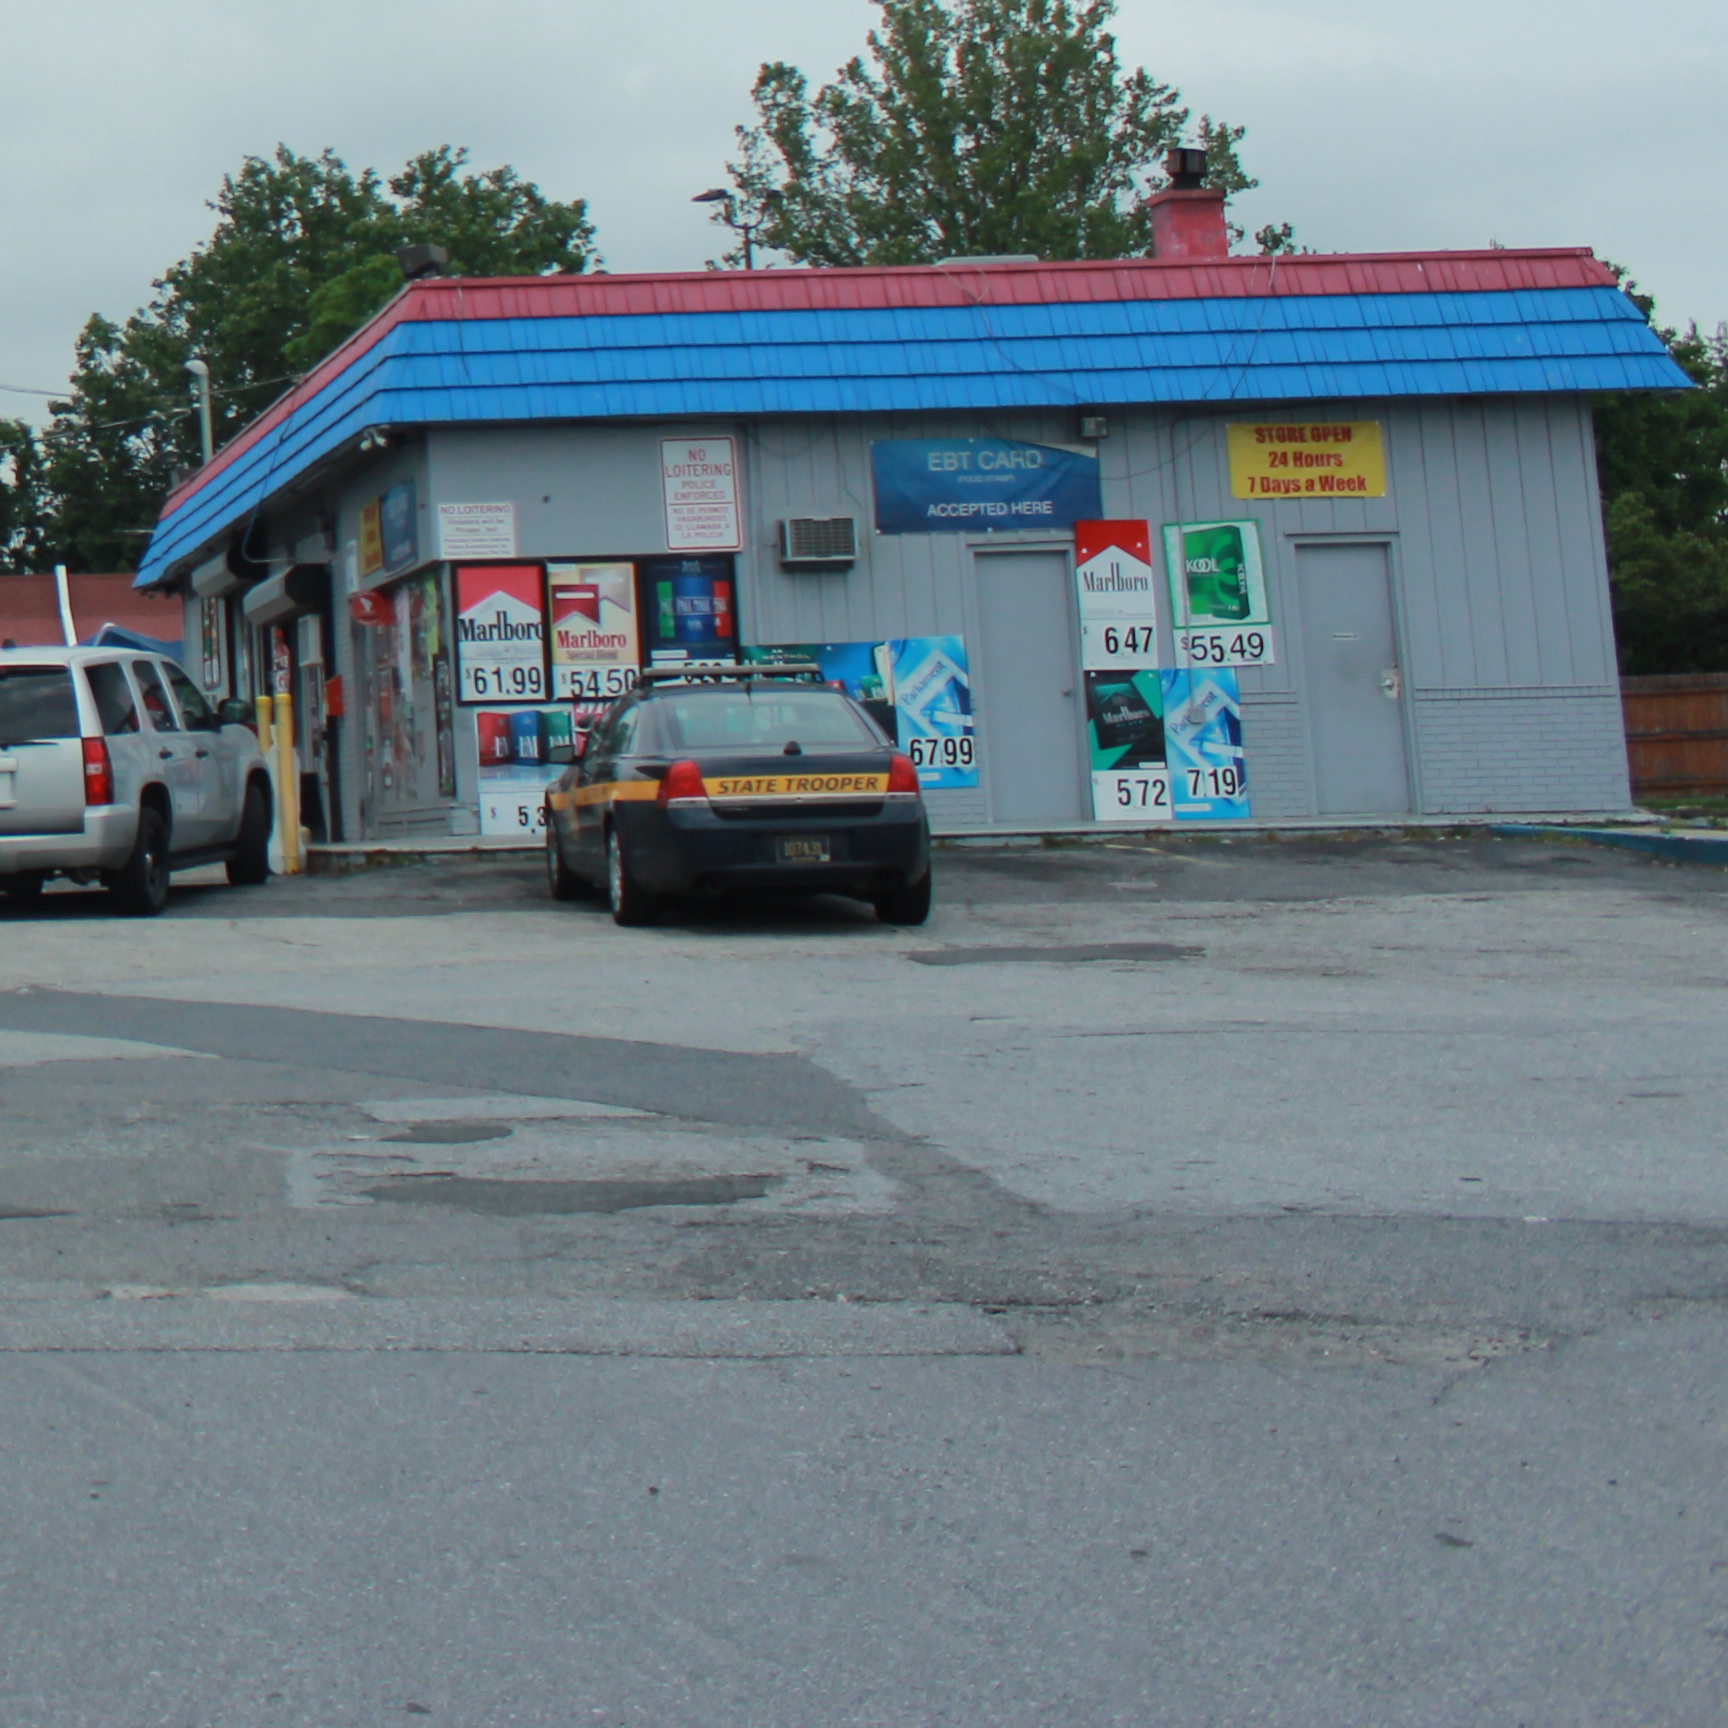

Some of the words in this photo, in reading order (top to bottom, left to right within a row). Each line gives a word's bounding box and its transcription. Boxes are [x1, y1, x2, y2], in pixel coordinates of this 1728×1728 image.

[1254, 425, 1308, 444] STORE
[1310, 424, 1352, 443] OPEN
[688, 448, 706, 462] NO
[927, 451, 972, 472] EBT
[977, 449, 1043, 471] CARD
[1268, 451, 1288, 468] 24
[1292, 450, 1343, 468] Hours
[664, 463, 732, 478] LOITERING
[682, 479, 717, 489] POLICE
[1247, 476, 1256, 494] 7
[1260, 476, 1302, 494] Days
[1305, 478, 1315, 491] a
[1318, 475, 1367, 492] Week
[440, 505, 455, 514] NO
[457, 504, 512, 514] LOITERING
[927, 502, 1008, 517] ACCEPTED
[1011, 500, 1053, 515] HERE
[1185, 557, 1221, 573] KOOL
[1082, 561, 1149, 592] Marlboro
[458, 610, 543, 642] Marlboro
[556, 629, 627, 649] Marlboro
[899, 659, 947, 706] Parliament
[1102, 705, 1151, 724] Marlboro
[717, 778, 777, 795] STATE
[784, 776, 880, 792] TROOPER
